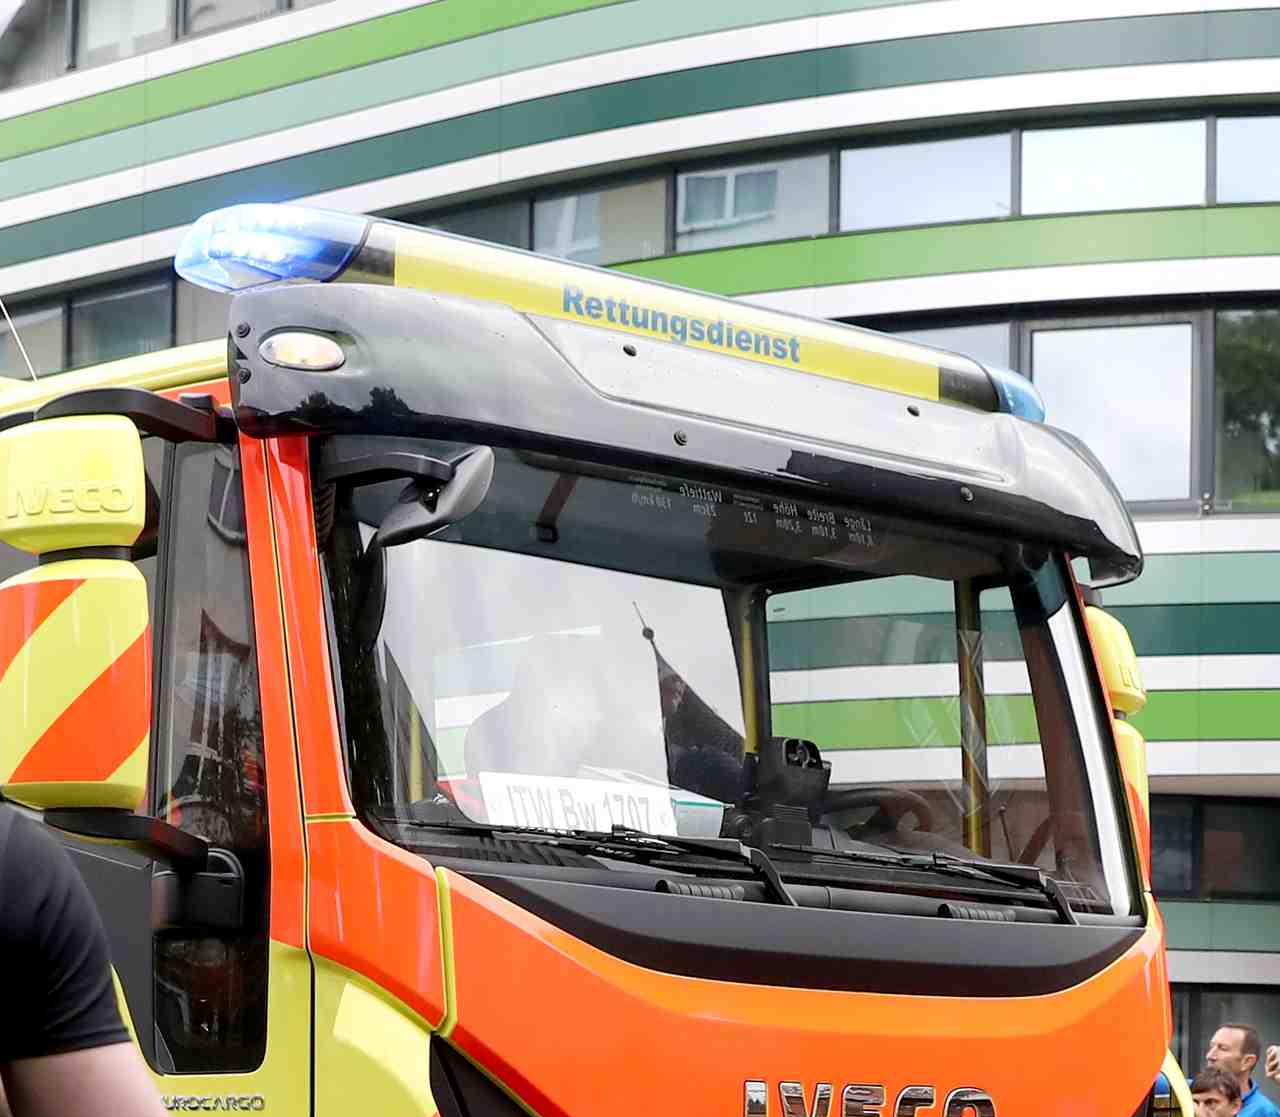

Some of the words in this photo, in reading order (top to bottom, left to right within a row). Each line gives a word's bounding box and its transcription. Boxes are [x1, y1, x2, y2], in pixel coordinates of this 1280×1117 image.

[561, 284, 801, 363] Rettungsdienst
[6, 484, 135, 519] IVECO
[560, 788, 598, 832] Bw
[603, 792, 651, 834] 1707
[161, 1096, 265, 1111] UROCARGO
